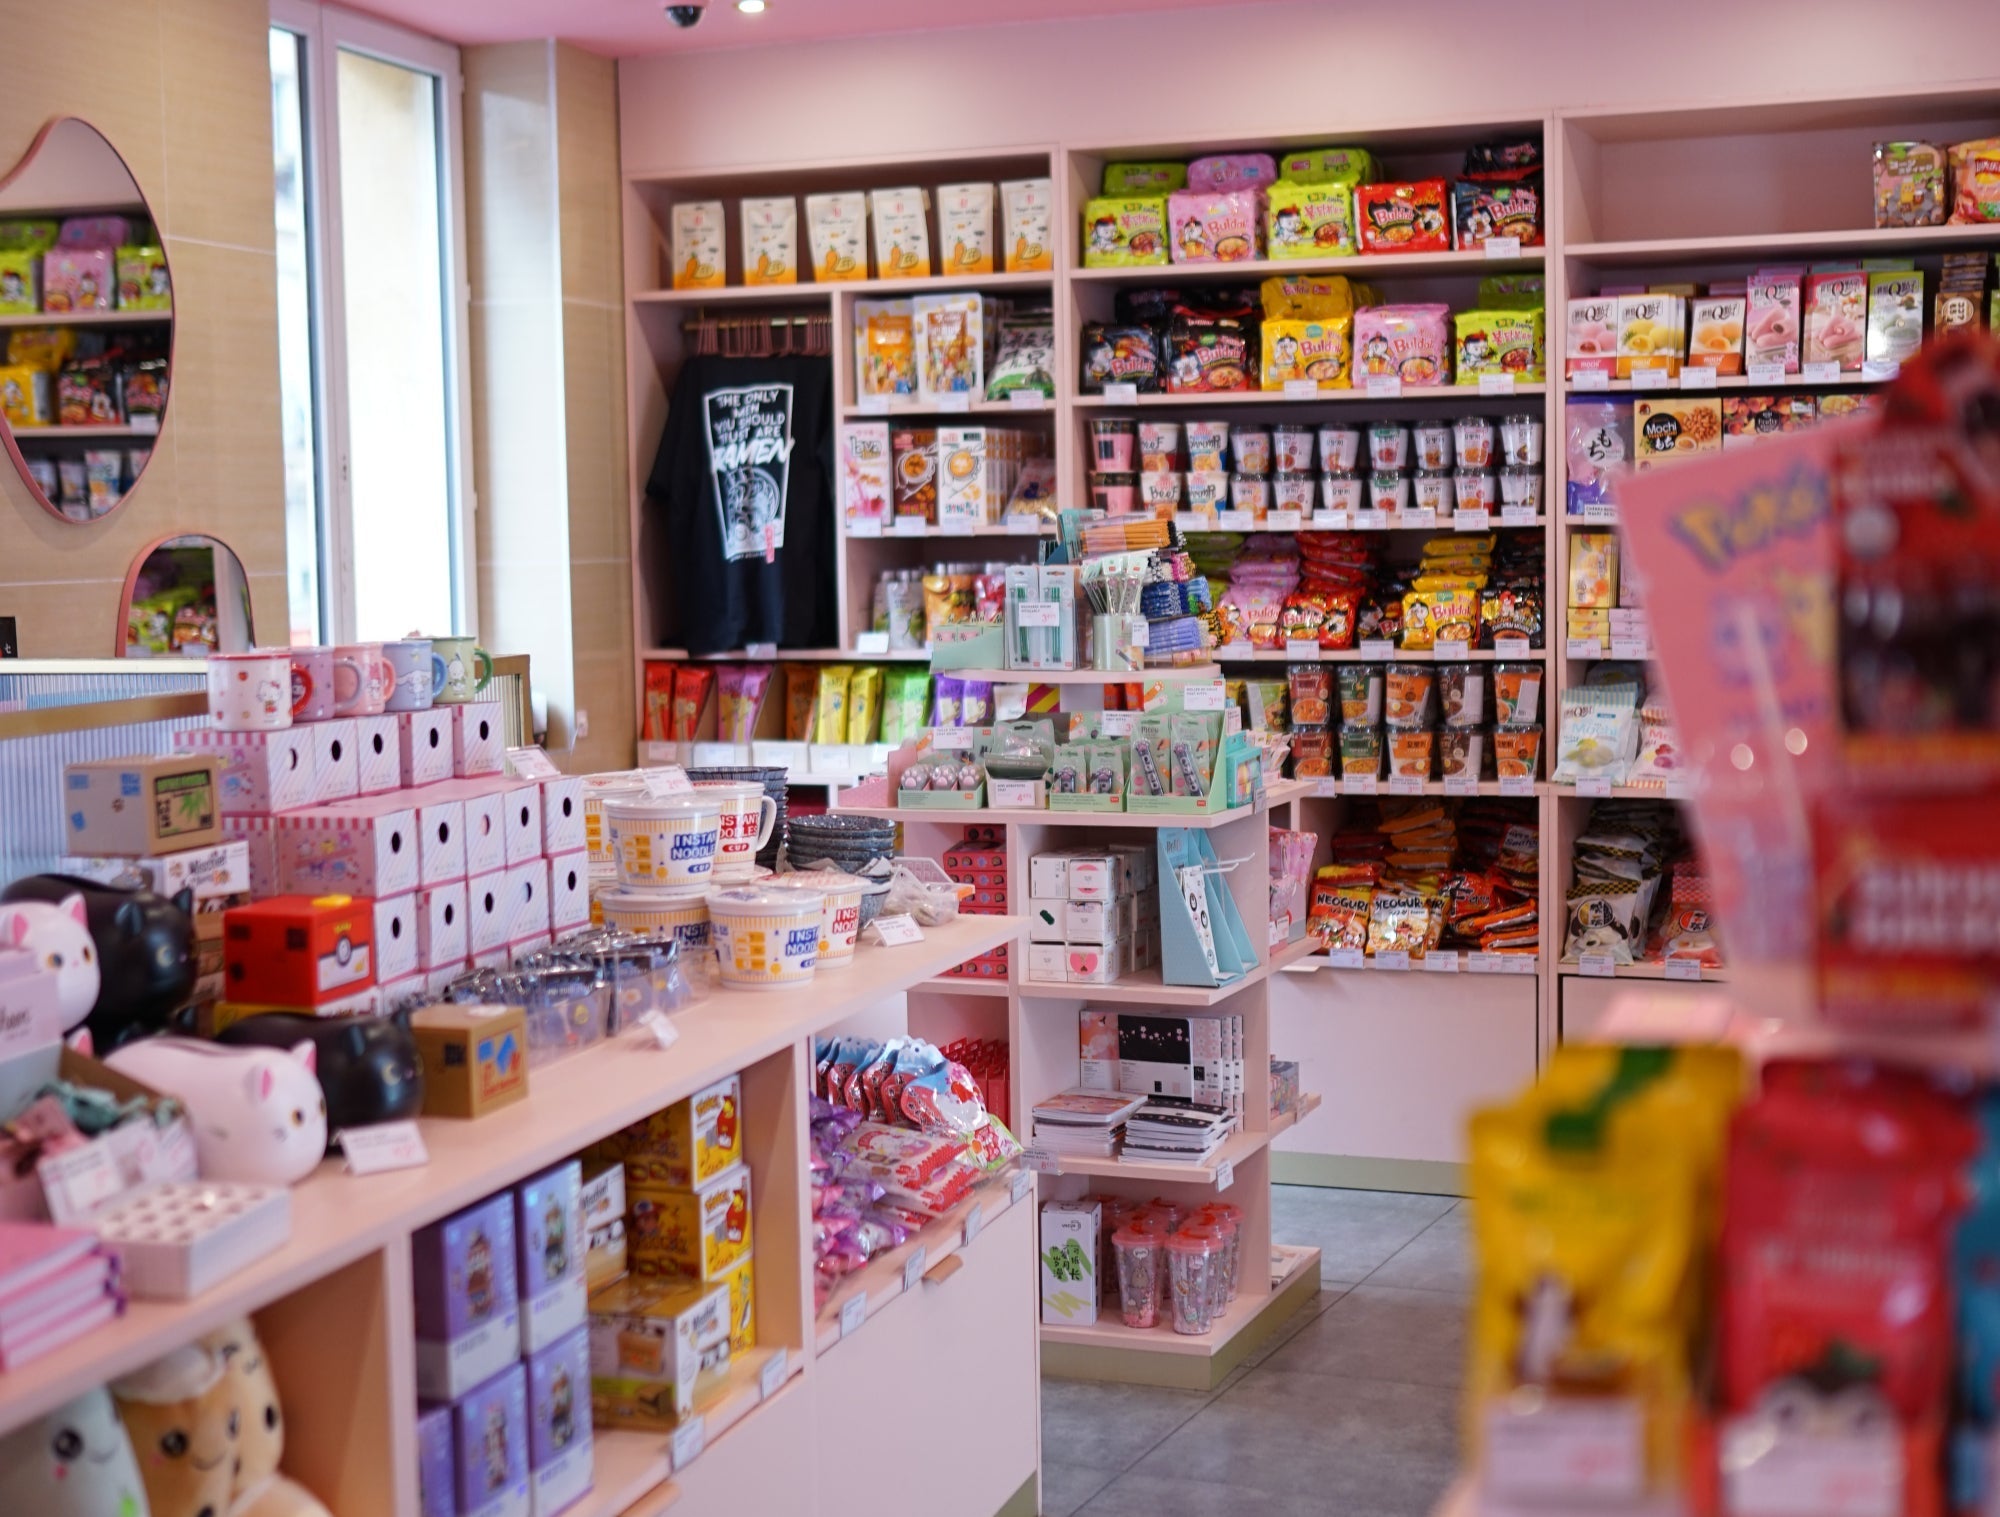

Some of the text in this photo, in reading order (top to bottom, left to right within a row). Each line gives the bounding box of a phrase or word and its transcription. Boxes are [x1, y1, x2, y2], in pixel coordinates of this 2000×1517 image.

[1488, 199, 1537, 221] Buldak
[1300, 339, 1342, 357] Buldak
[1393, 337, 1434, 352] Buldak
[1197, 346, 1246, 364] Buldak
[1110, 357, 1155, 376] Buldak
[744, 390, 779, 405] ONLY
[733, 403, 760, 418] MEN
[739, 413, 785, 430] SHOULD
[1646, 422, 1677, 435] Mochi
[755, 425, 781, 438] ARE
[1655, 437, 1674, 450] もち
[714, 437, 796, 472] RAMEN
[1431, 603, 1473, 620] Buldak
[1573, 723, 1617, 736] Mochi
[671, 844, 716, 860] NOODLE
[728, 844, 747, 852] CUP
[693, 864, 710, 873] CUP
[1317, 893, 1369, 913] NEOGURI
